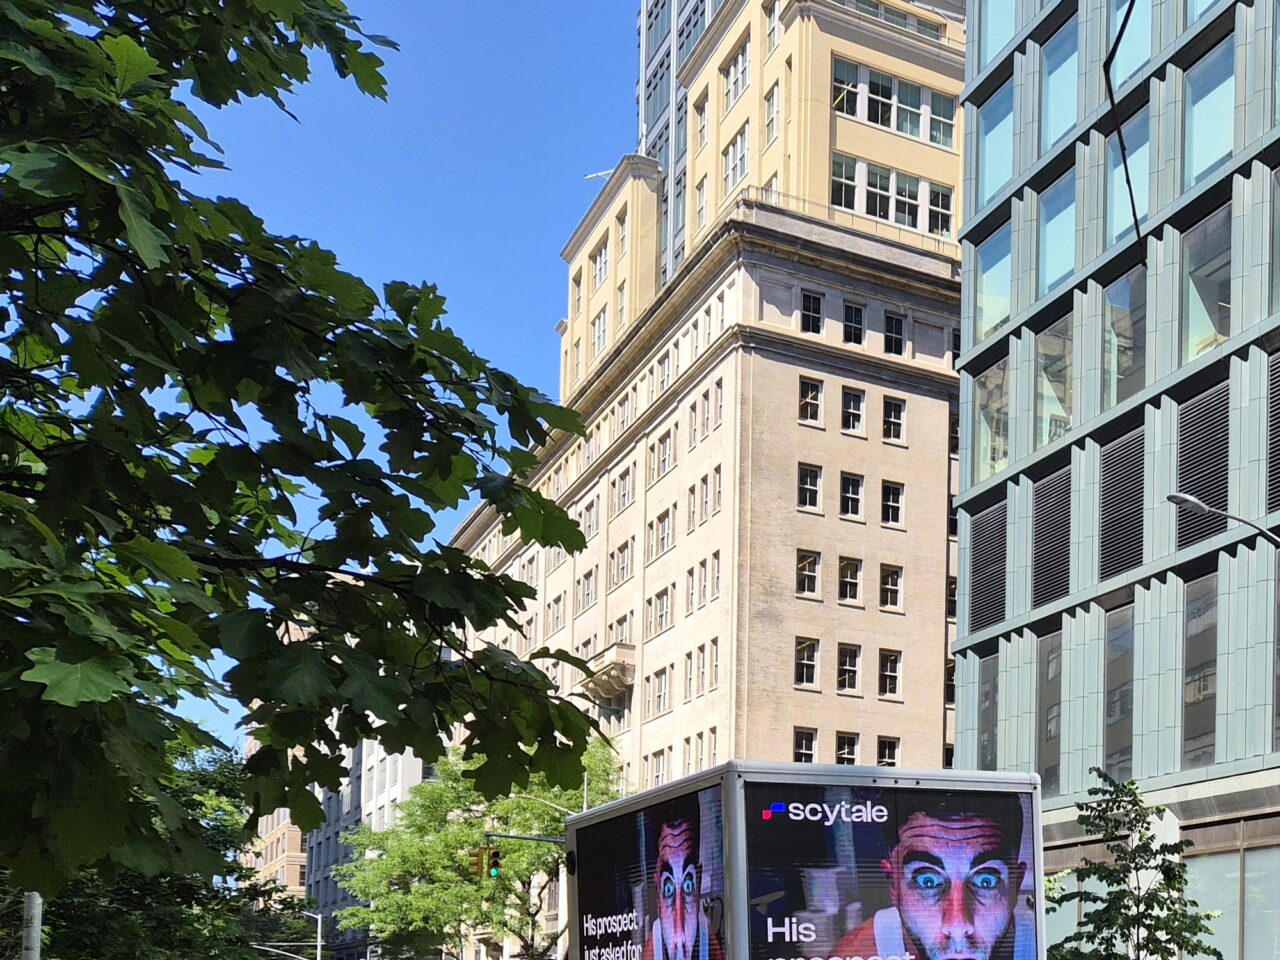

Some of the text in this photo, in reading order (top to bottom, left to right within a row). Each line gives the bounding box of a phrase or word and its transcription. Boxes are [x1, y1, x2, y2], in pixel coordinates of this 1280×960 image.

[788, 801, 889, 826] scytale
[583, 909, 638, 940] His prospect
[767, 917, 817, 943] His
